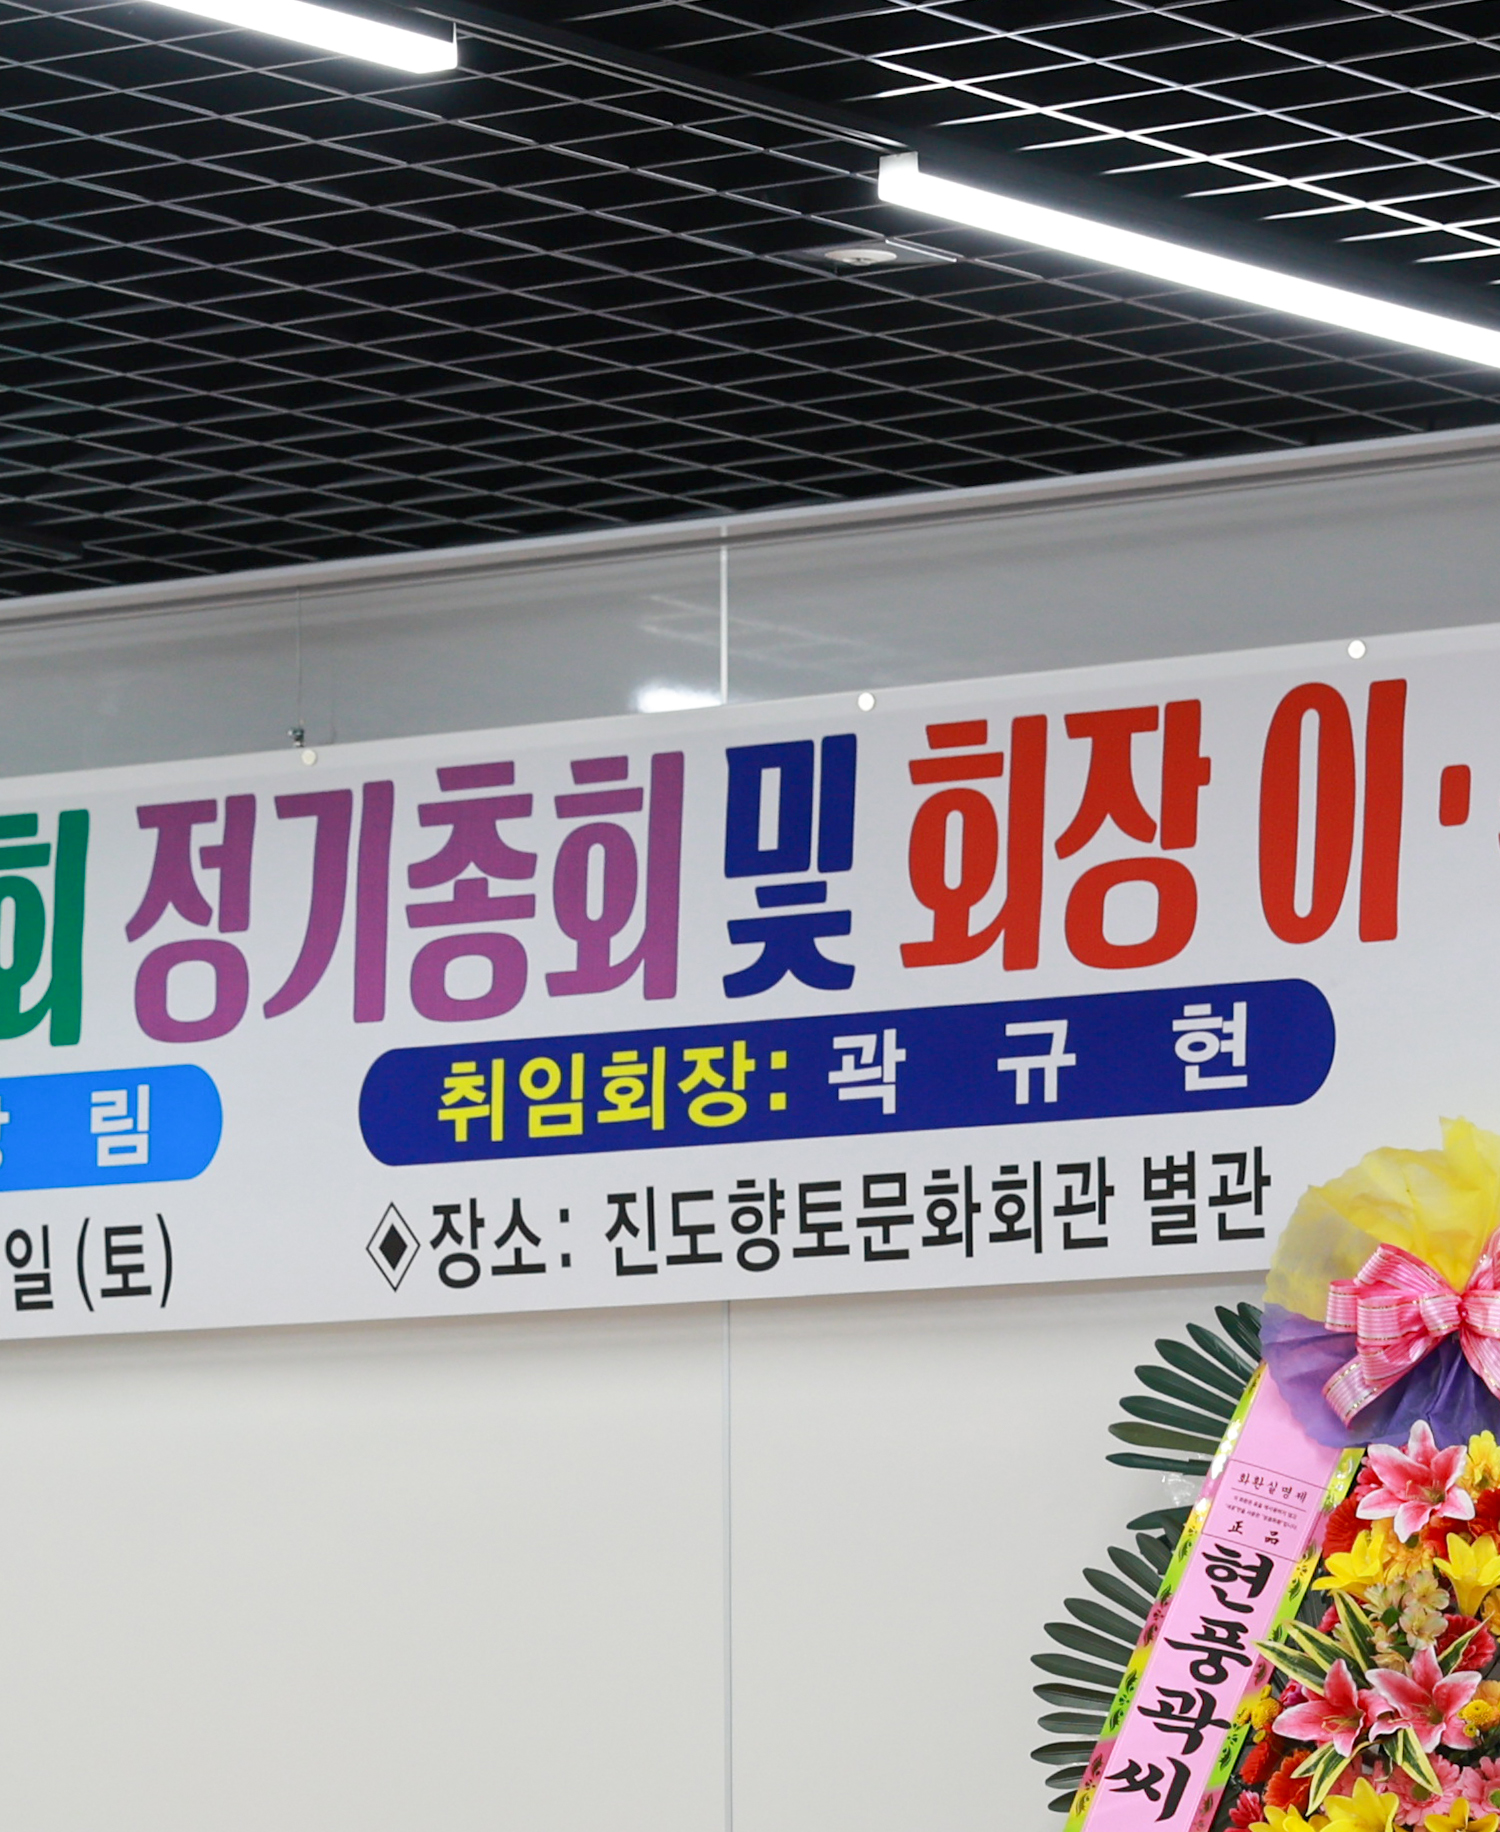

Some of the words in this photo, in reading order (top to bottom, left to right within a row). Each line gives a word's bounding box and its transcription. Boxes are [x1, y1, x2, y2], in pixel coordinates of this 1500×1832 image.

[125, 751, 685, 1044] 정기총회
[722, 733, 858, 999] 및
[900, 699, 1211, 971] 회장
[437, 1040, 790, 1143] 취임회장:
[75, 1212, 175, 1312] (토)
[430, 1198, 571, 1289] 장소:
[605, 1156, 1115, 1276] 진도향토문화회관
[1141, 1144, 1271, 1248] 별관
[1105, 1542, 1274, 1823] 현풍곽씨
